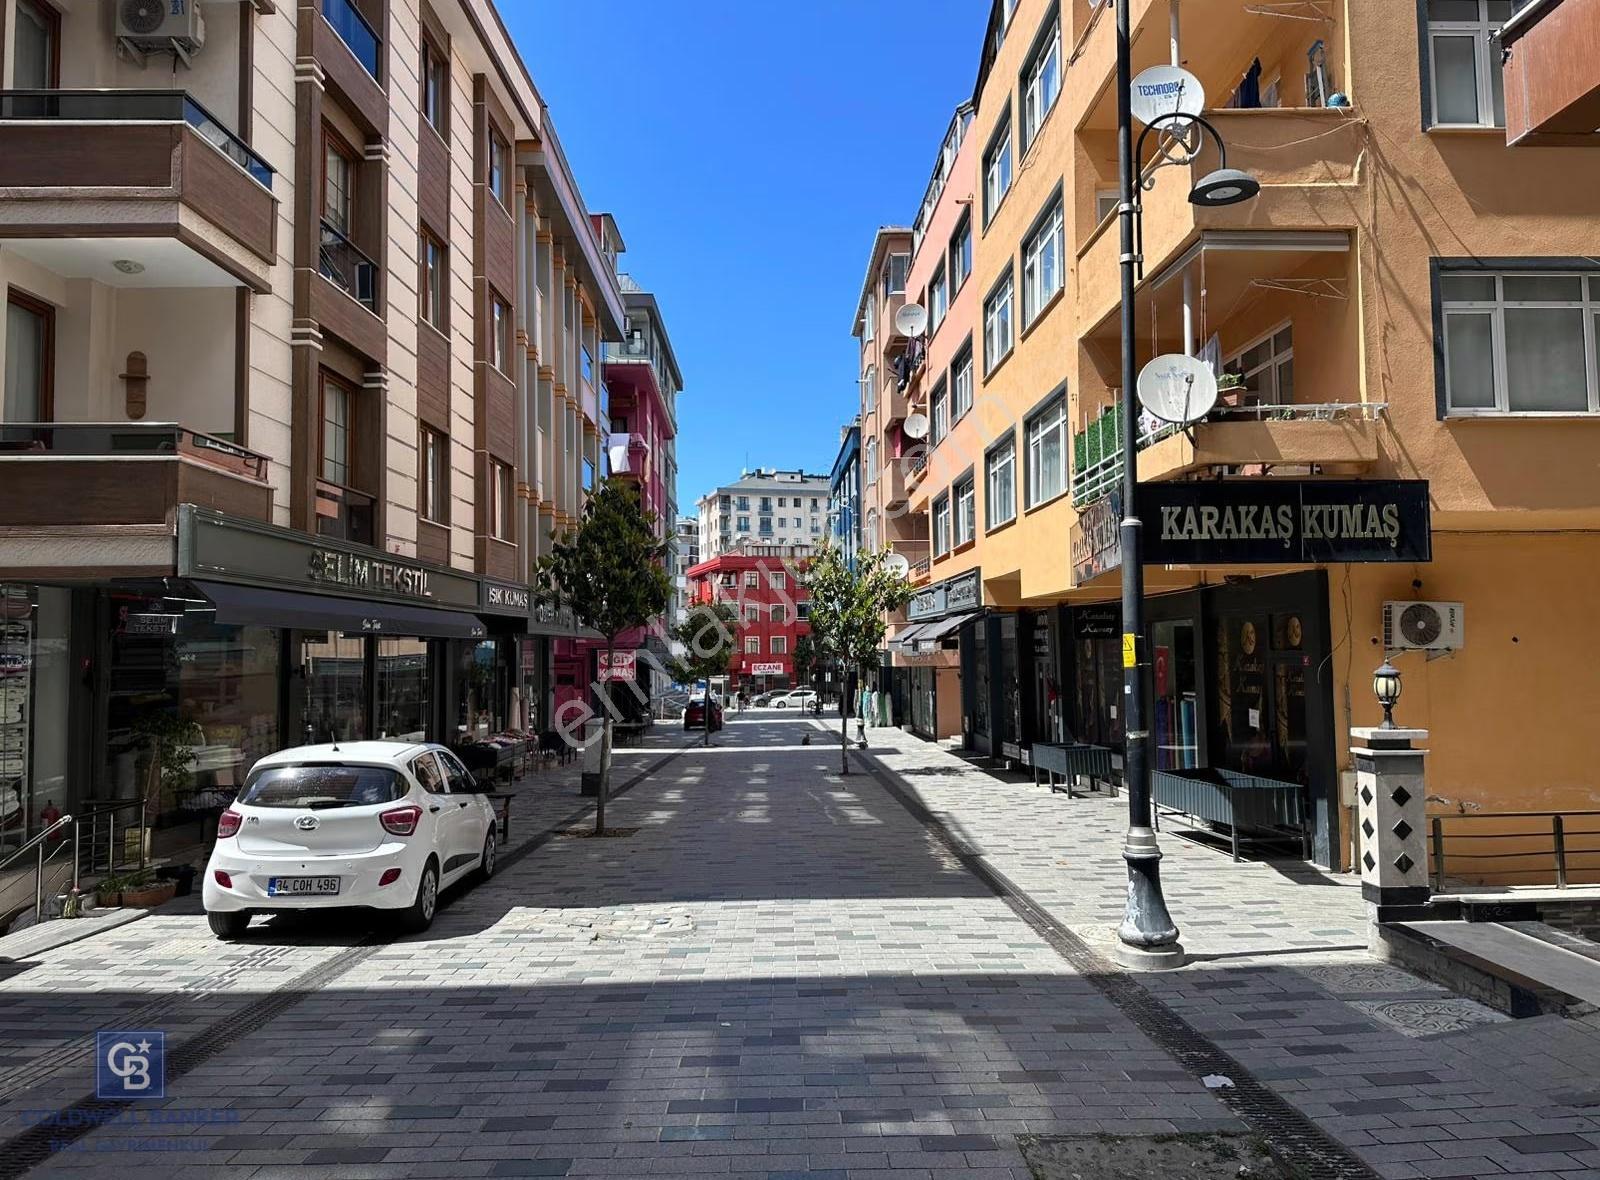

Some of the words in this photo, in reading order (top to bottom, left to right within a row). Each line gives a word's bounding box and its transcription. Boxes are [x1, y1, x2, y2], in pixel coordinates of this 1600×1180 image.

[1160, 504, 1294, 549] KARAKAŞ
[1301, 503, 1400, 548] KUMAŞ
[372, 562, 433, 597] TEKSTİL
[753, 664, 782, 672] ECZANE
[276, 880, 289, 891] 34
[316, 879, 336, 891] 496
